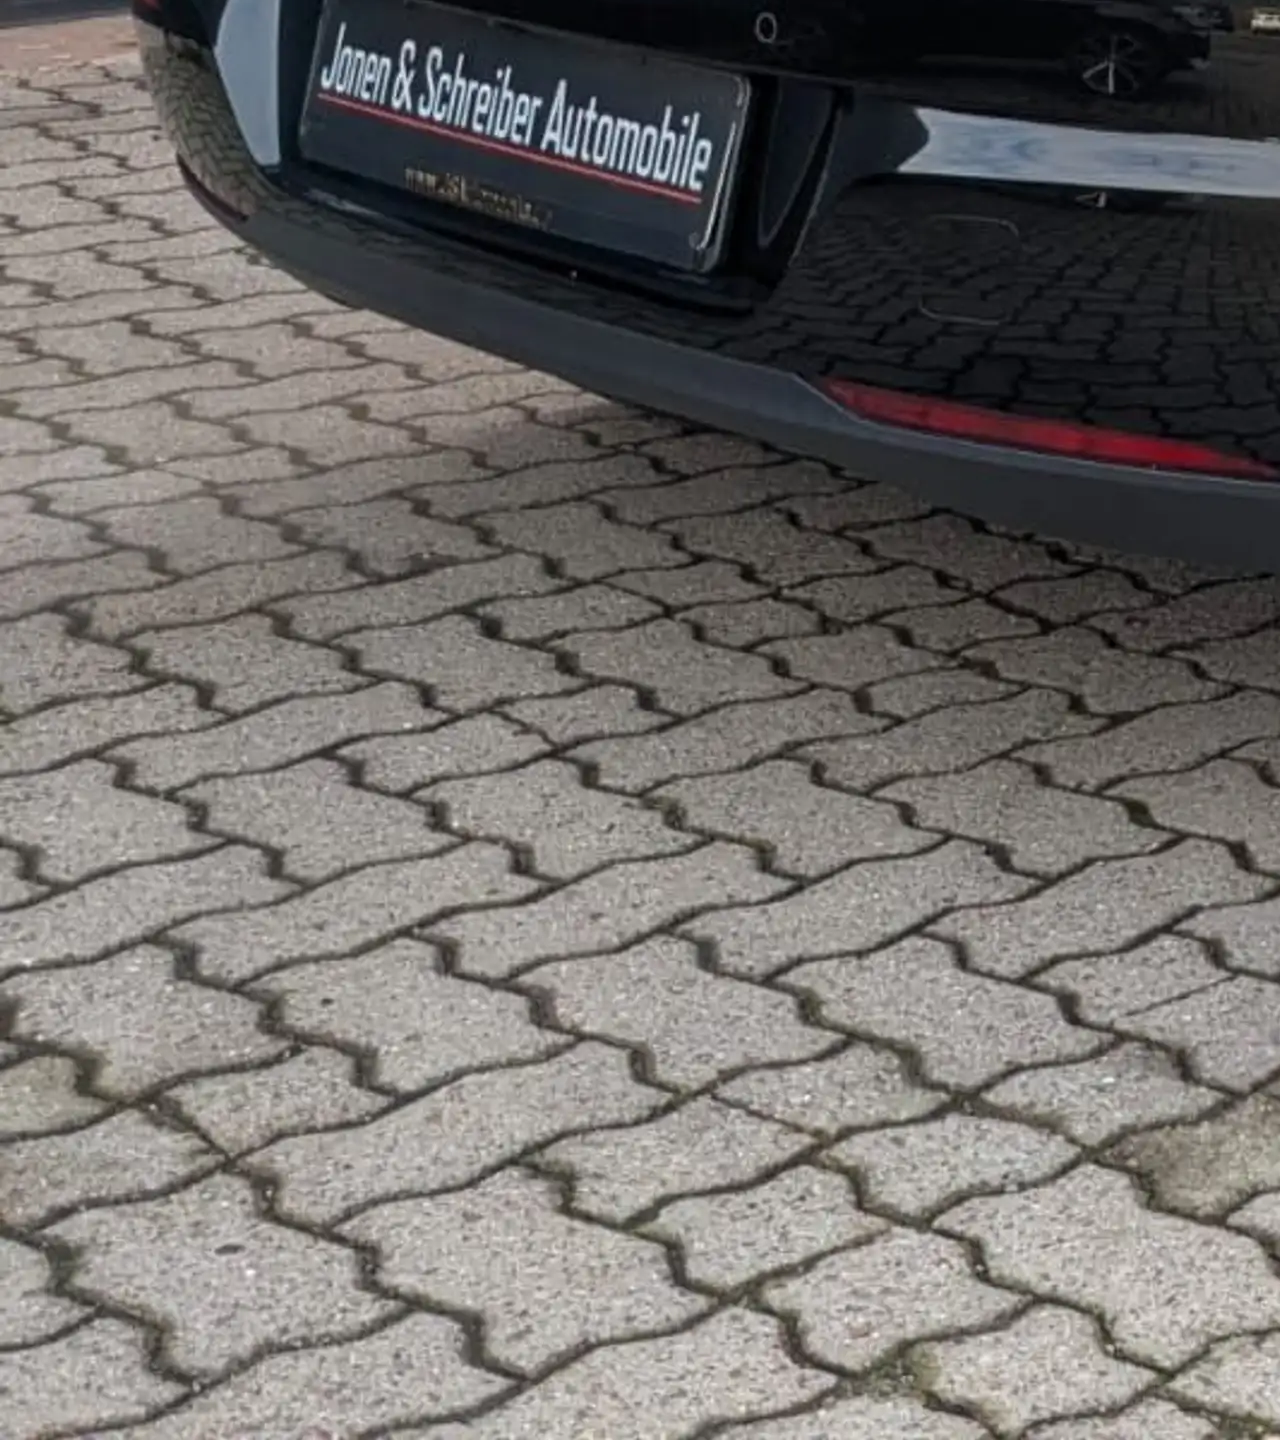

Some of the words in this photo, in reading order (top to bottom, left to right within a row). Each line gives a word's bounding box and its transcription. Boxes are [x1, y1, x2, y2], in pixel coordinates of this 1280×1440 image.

[321, 22, 392, 105] Jonen
[392, 39, 418, 112] &
[417, 47, 543, 147] Schreiber
[540, 78, 712, 191] Automobile
